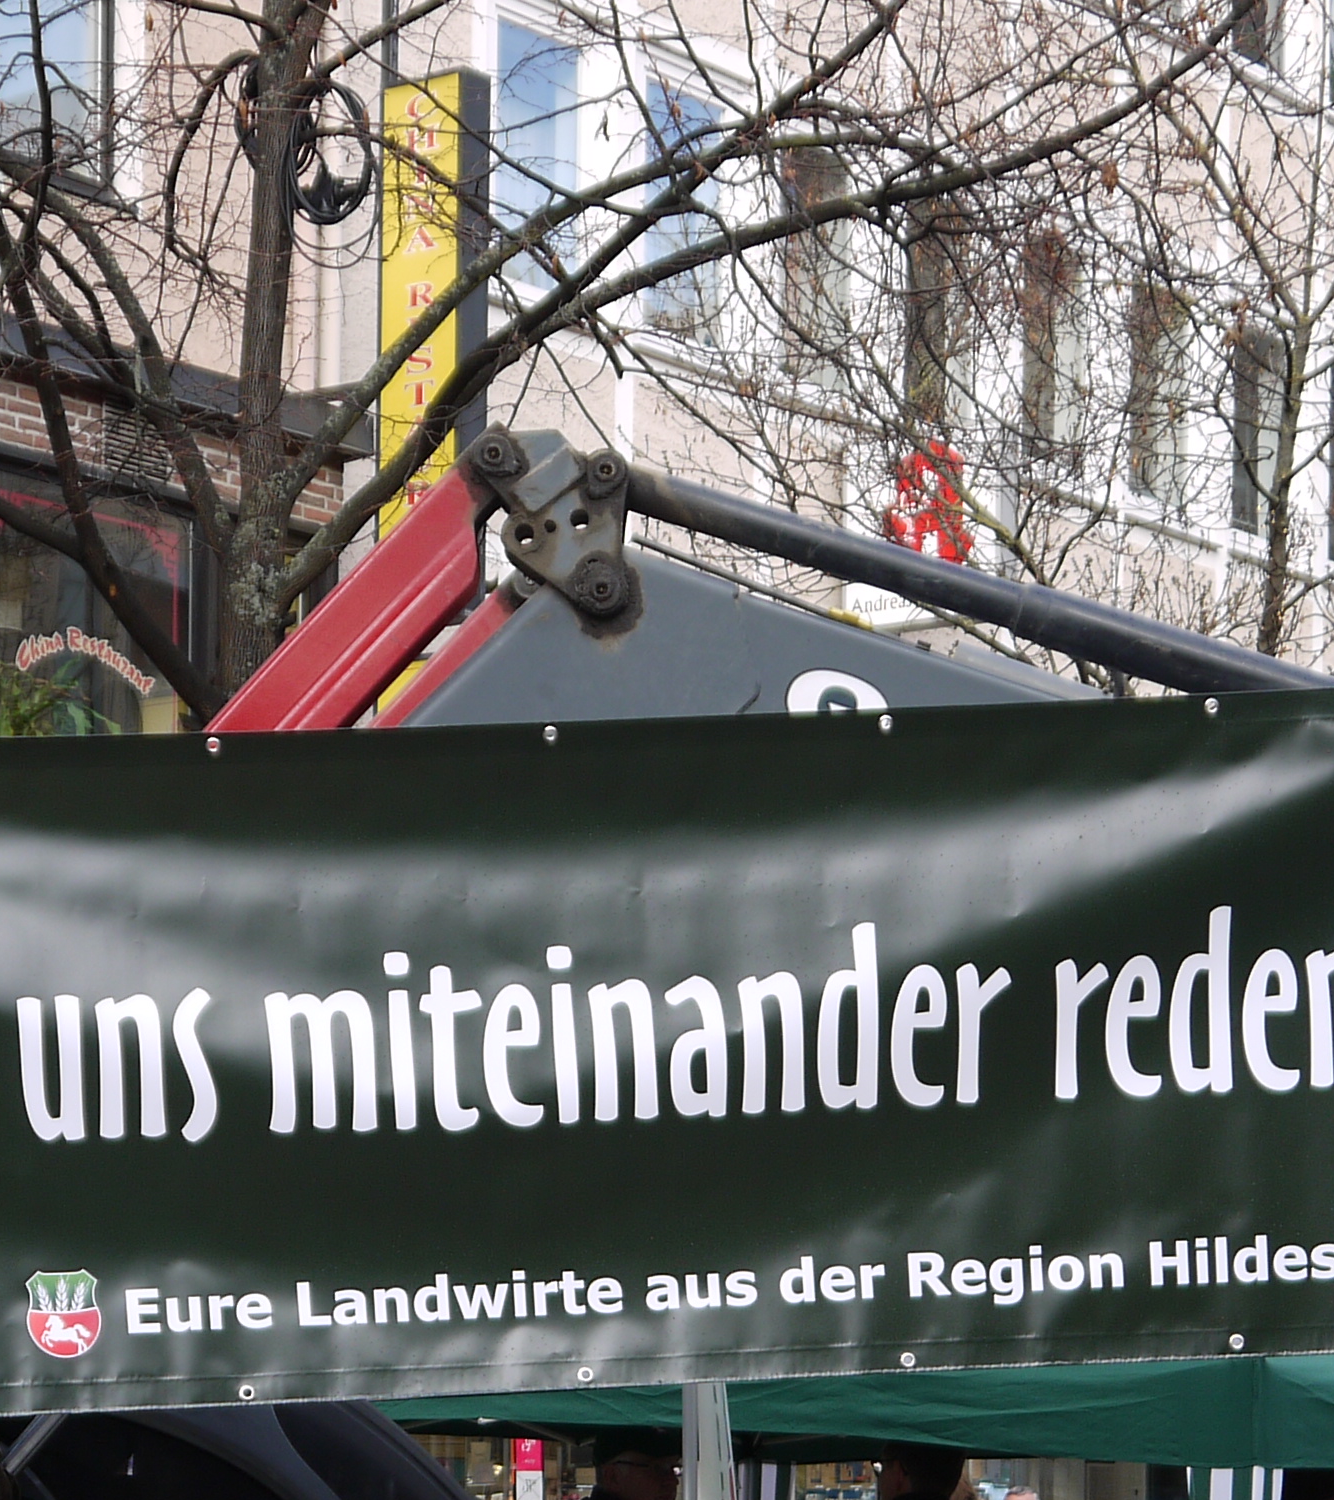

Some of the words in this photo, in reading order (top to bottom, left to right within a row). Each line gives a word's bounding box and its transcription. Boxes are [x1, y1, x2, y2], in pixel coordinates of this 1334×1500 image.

[16, 631, 65, 672] China
[67, 626, 156, 695] Restaurant
[16, 986, 218, 1145] uns
[262, 921, 1013, 1134] miteinander
[125, 1286, 273, 1336] Eure
[296, 1268, 625, 1328] Landwirte
[645, 1269, 759, 1310] aus
[779, 1256, 885, 1304] der
[908, 1244, 1126, 1306] Region
